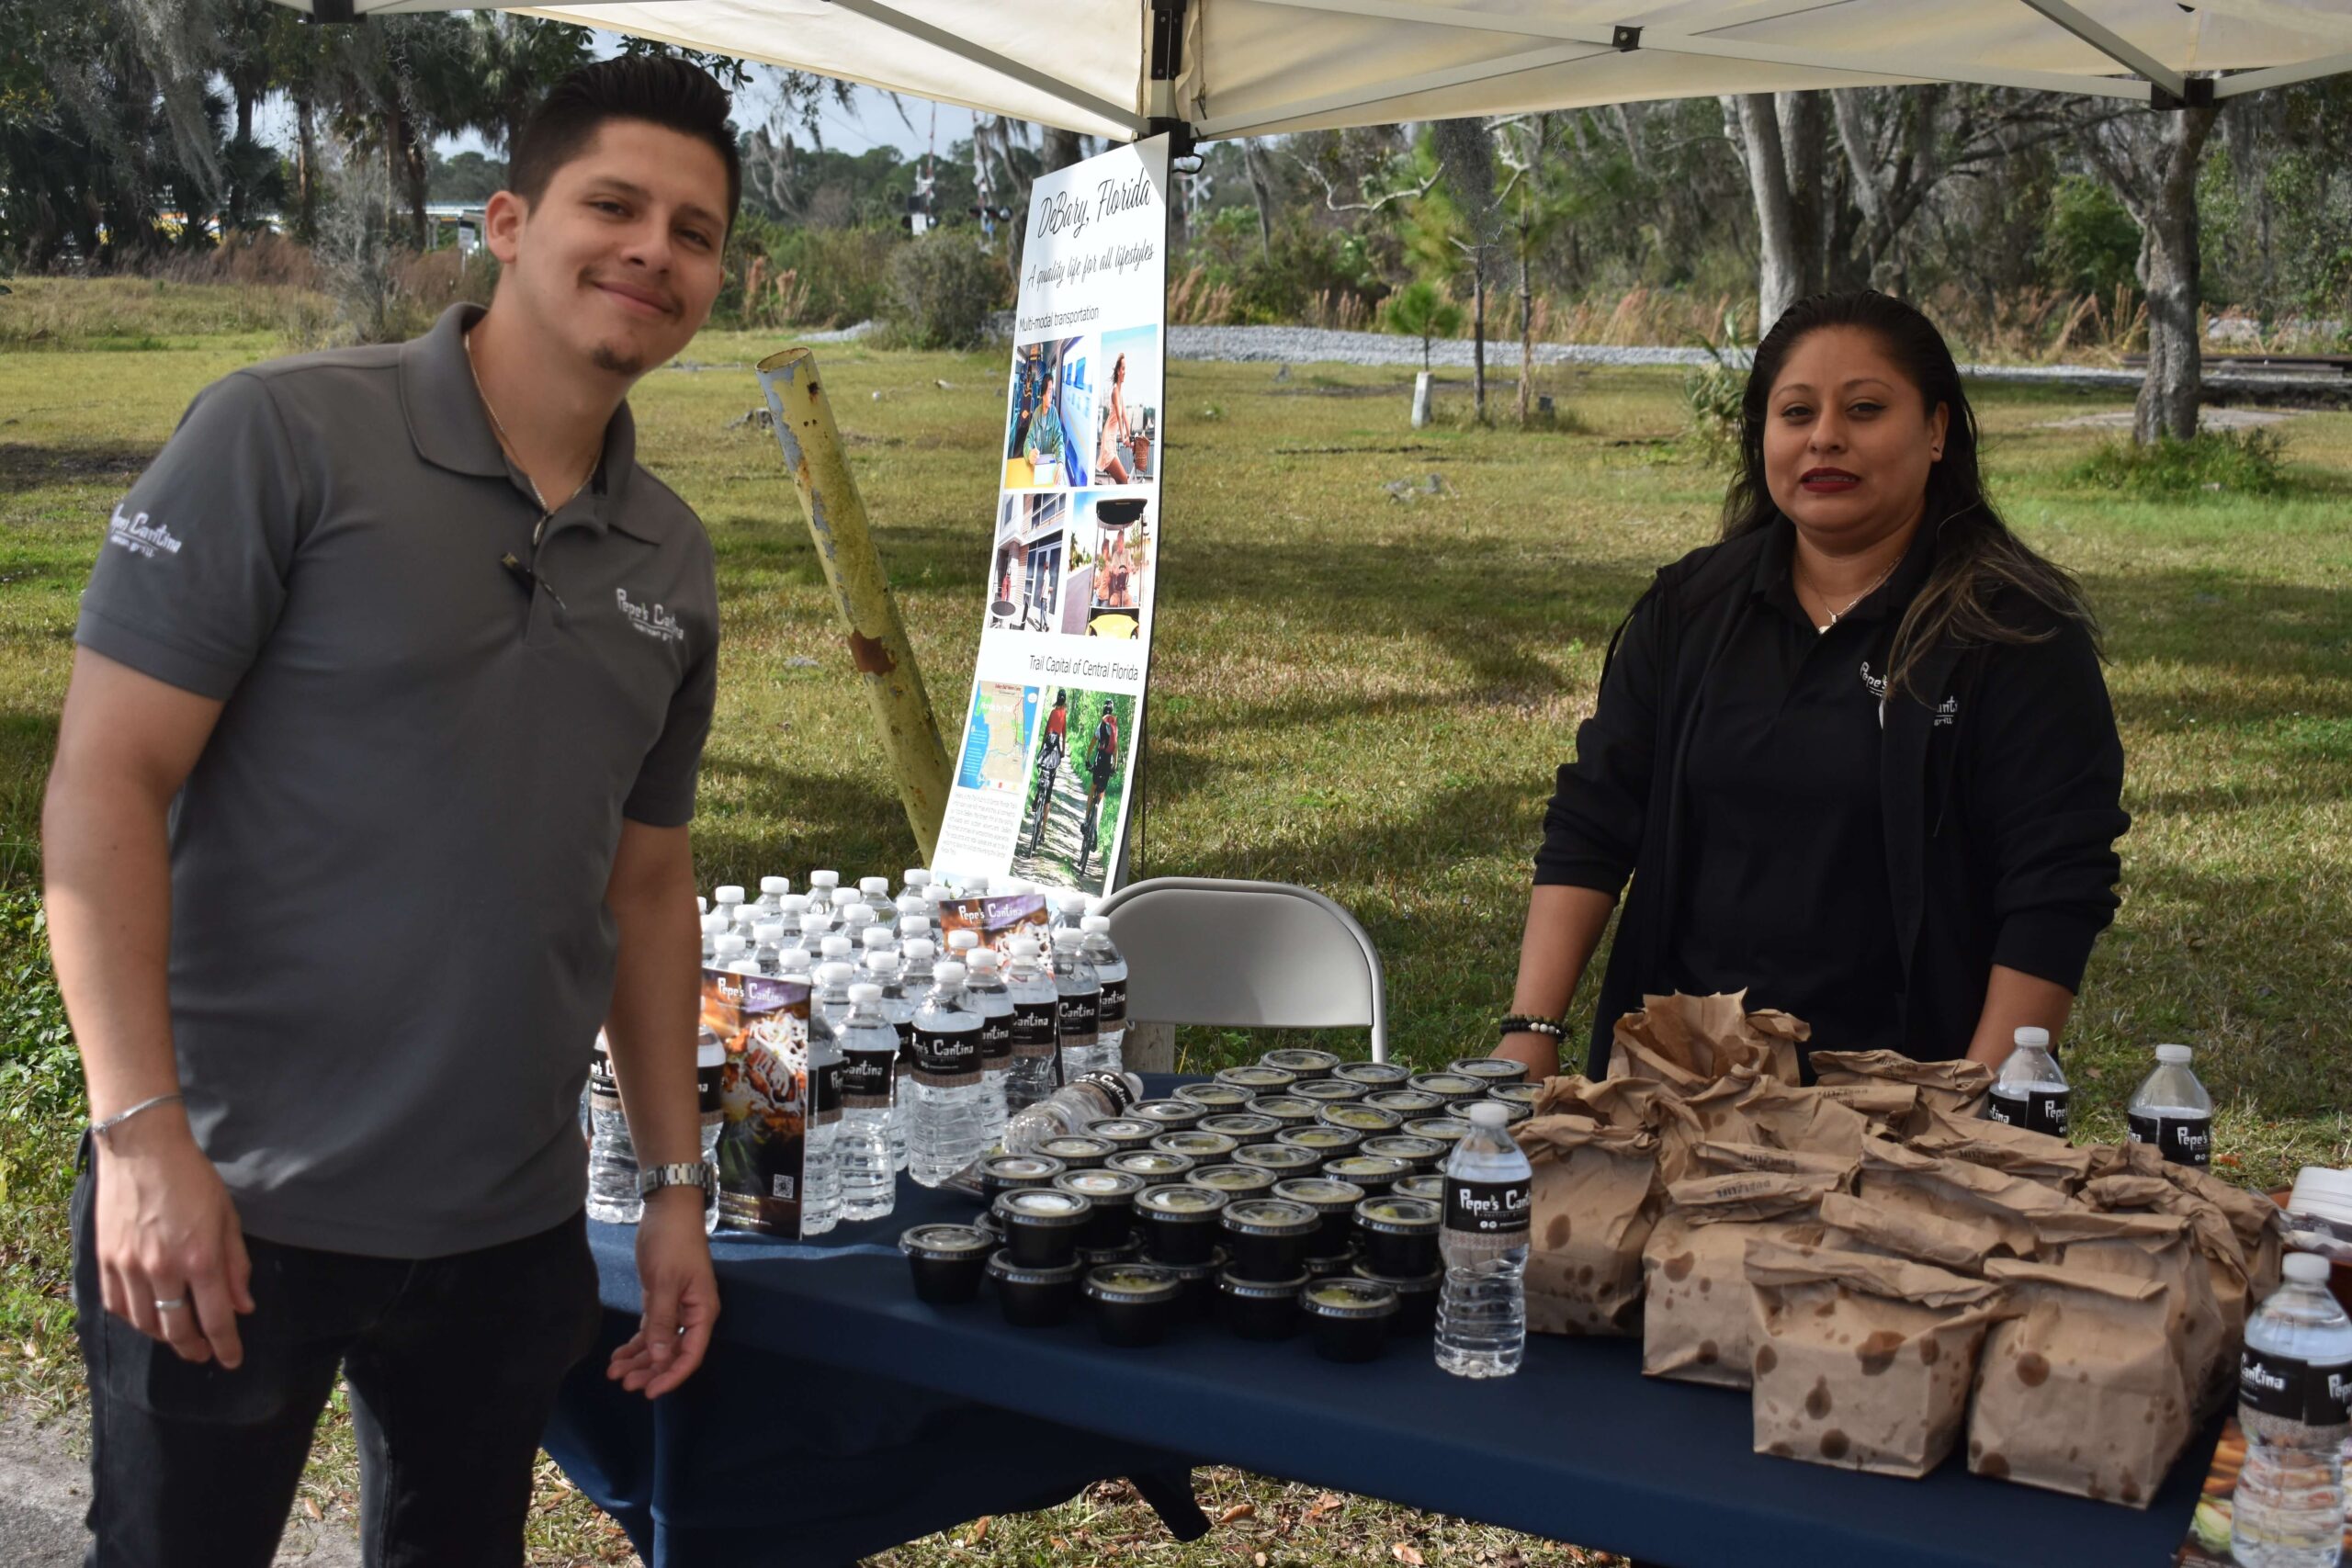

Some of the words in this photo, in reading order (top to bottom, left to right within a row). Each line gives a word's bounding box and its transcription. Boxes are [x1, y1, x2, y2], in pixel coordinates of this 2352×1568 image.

[1038, 191, 1089, 238] DeBary,
[1097, 167, 1150, 222] Florida
[1026, 264, 1037, 290] A
[1036, 259, 1065, 292] quality
[1067, 255, 1081, 285] life
[1081, 254, 1097, 283] for
[1100, 246, 1114, 271] all
[1114, 238, 1155, 275] lifestyles
[1019, 310, 1054, 333] Multi-modal
[1054, 305, 1099, 327] transportation
[130, 512, 182, 554] Cantina
[616, 588, 649, 621] Pepe's
[1030, 655, 1045, 671] Trail
[1046, 656, 1072, 675] Capital
[1072, 659, 1082, 674] of
[1082, 660, 1110, 678] Central
[1112, 662, 1138, 681] Florida
[1860, 661, 1888, 689] Pepe's
[958, 904, 986, 924] Pepe's
[988, 903, 1023, 919] Cantina
[718, 977, 745, 1000] Pepe's
[749, 982, 785, 1004] Cantina
[1059, 1002, 1095, 1018] Cantina
[983, 1025, 1009, 1041] ntina
[933, 1039, 974, 1056] Cantina
[2045, 1100, 2069, 1123] Pepe'
[2177, 1126, 2208, 1151] Pepe's
[1459, 1188, 1499, 1217] Pepe's
[1506, 1189, 1532, 1210] Cant
[2327, 1373, 2352, 1404] Pep
